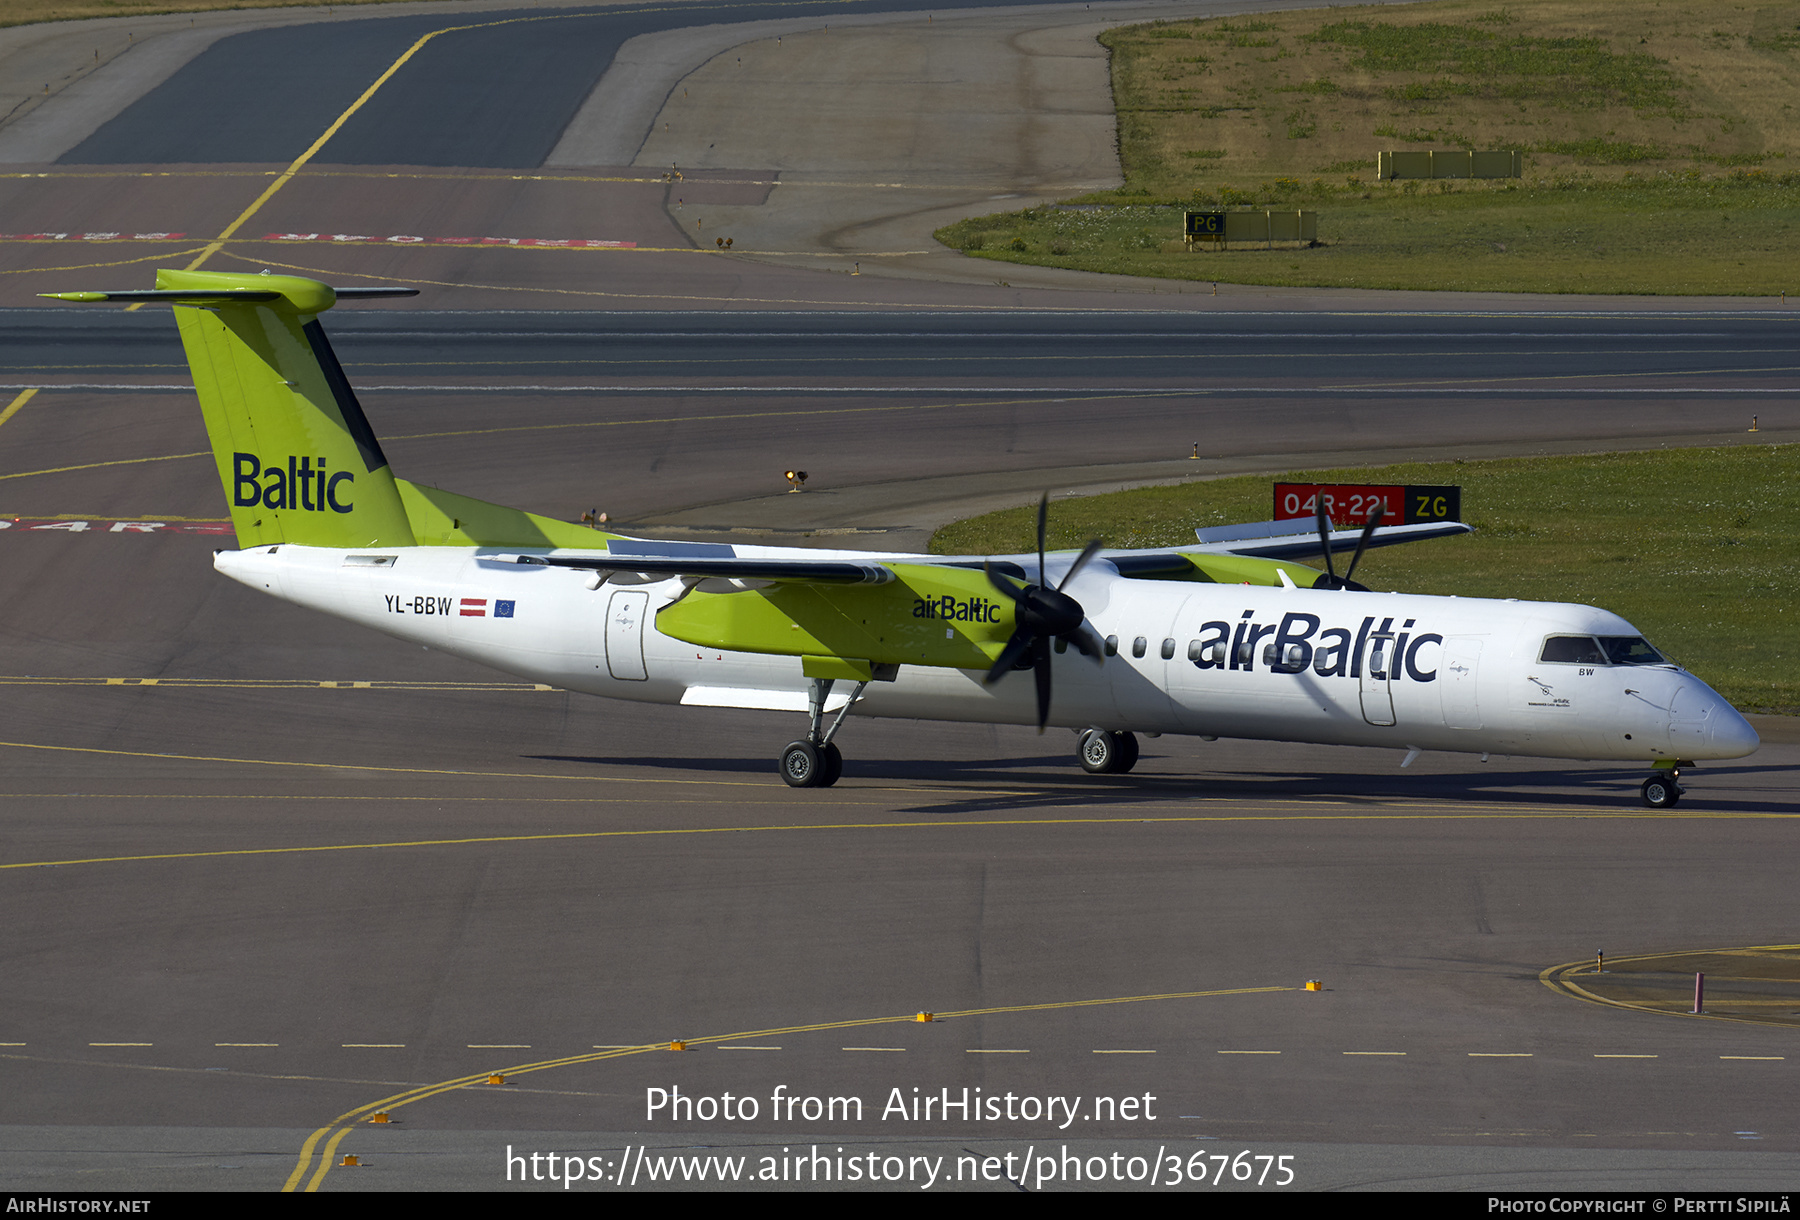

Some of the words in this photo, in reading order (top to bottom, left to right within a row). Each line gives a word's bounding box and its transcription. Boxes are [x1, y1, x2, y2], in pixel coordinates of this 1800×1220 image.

[1194, 216, 1217, 231] PG
[233, 452, 354, 514] Baltic
[1284, 493, 1396, 516] 04R-22L
[1416, 496, 1448, 517] ZG
[385, 595, 453, 616] YL-BBW
[912, 594, 1001, 623] airBaltic
[1193, 610, 1444, 683] airBaltic
[1578, 667, 1595, 677] BW
